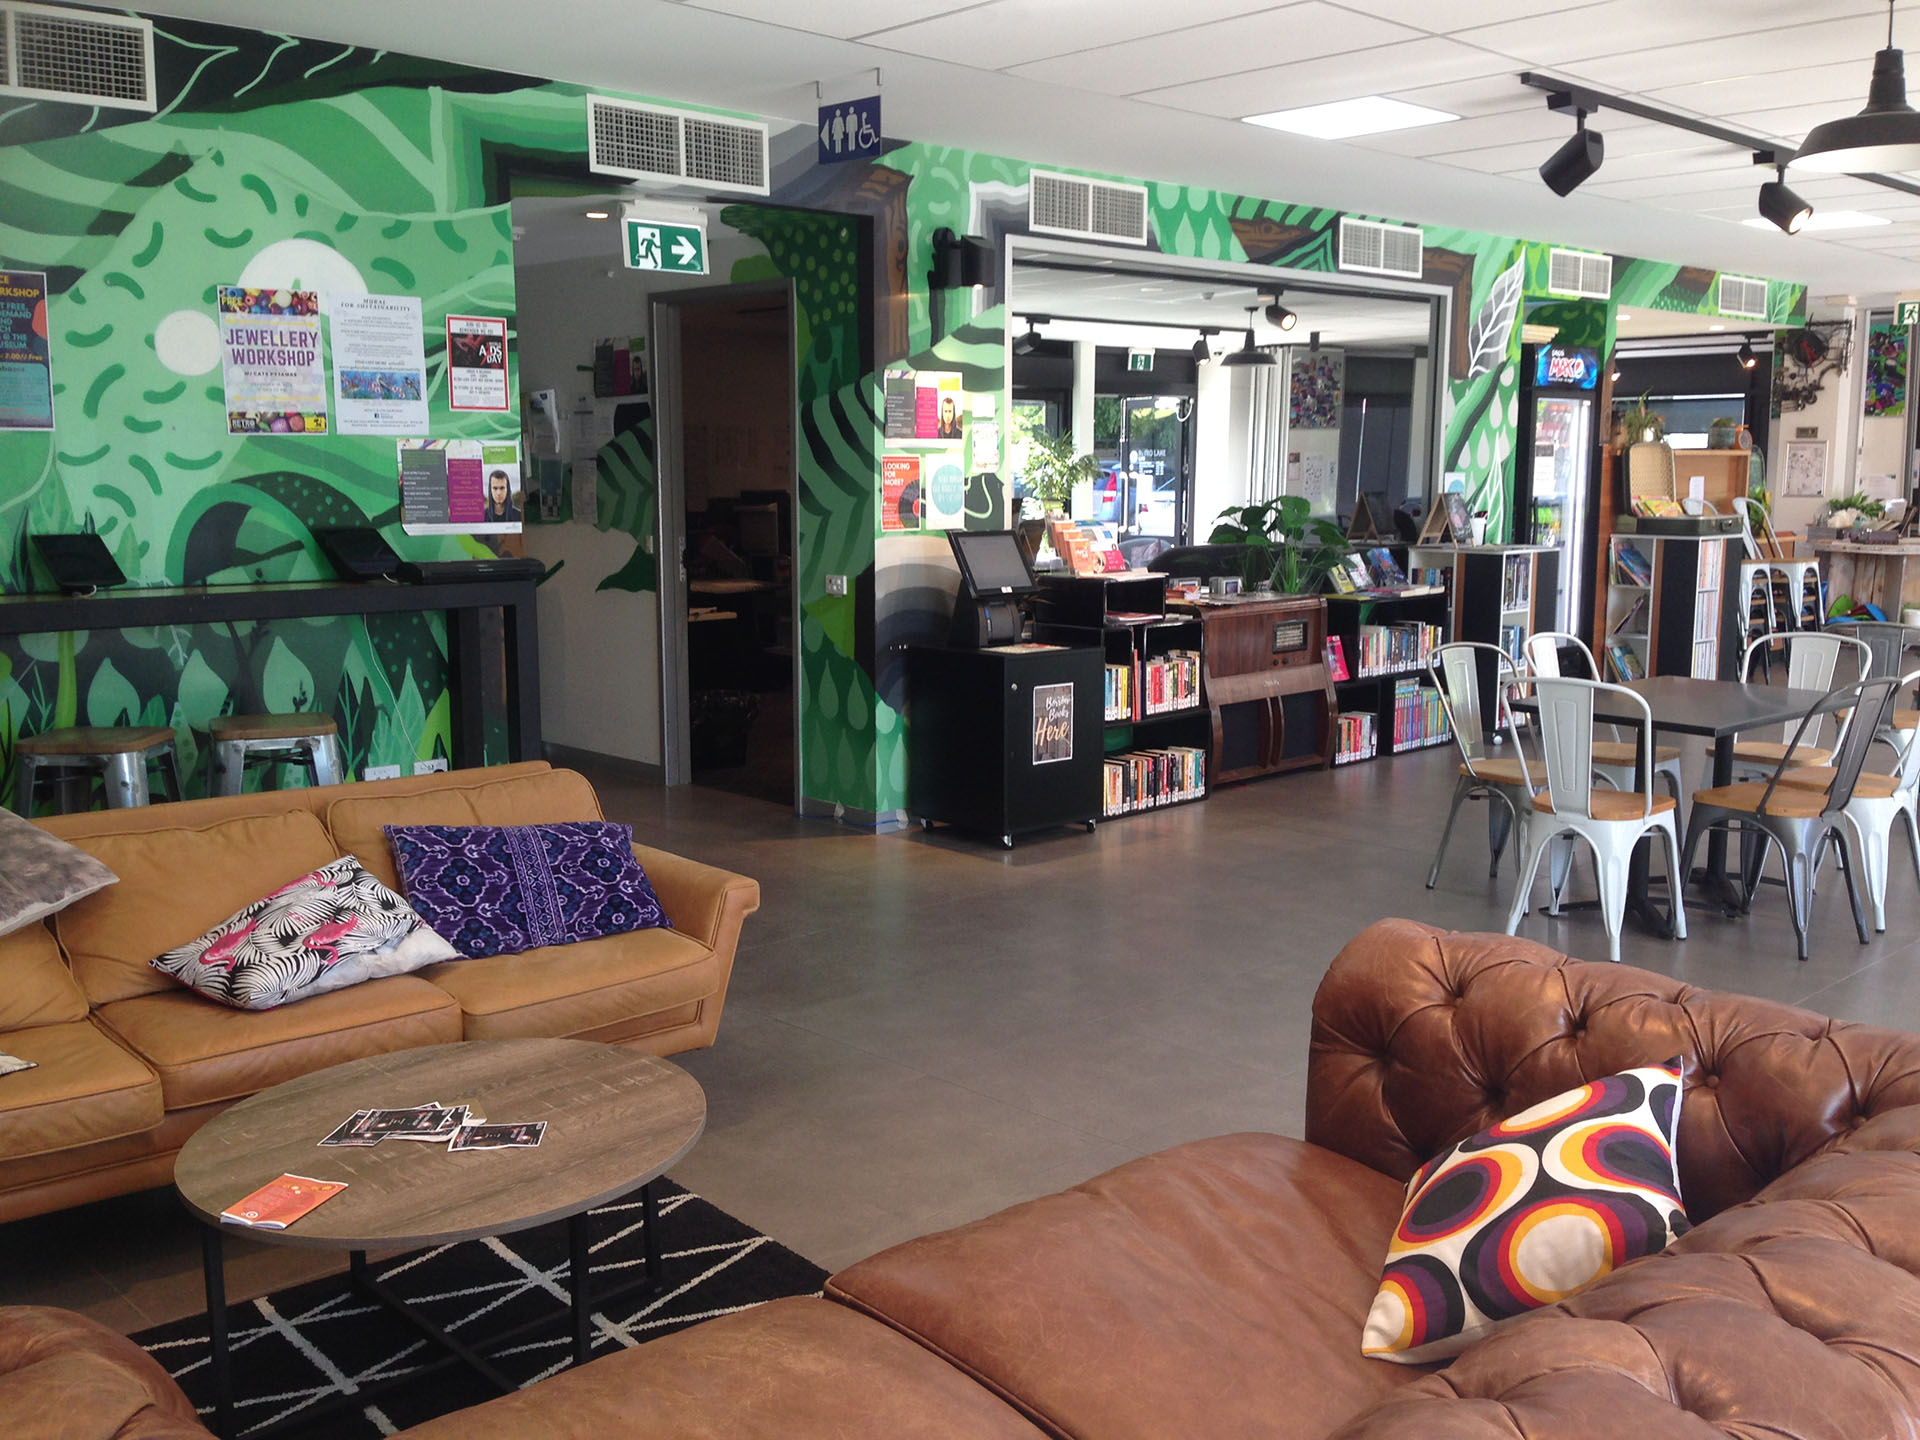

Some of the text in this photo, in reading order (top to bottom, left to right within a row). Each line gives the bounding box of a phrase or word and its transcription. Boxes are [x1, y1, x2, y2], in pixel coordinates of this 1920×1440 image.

[226, 329, 318, 348] JEWELLERY
[232, 348, 315, 367] WORKSHOP
[487, 355, 502, 364] DAY
[1549, 357, 1575, 377] MAX
[884, 478, 904, 486] MORE?
[1035, 717, 1069, 746] Here
